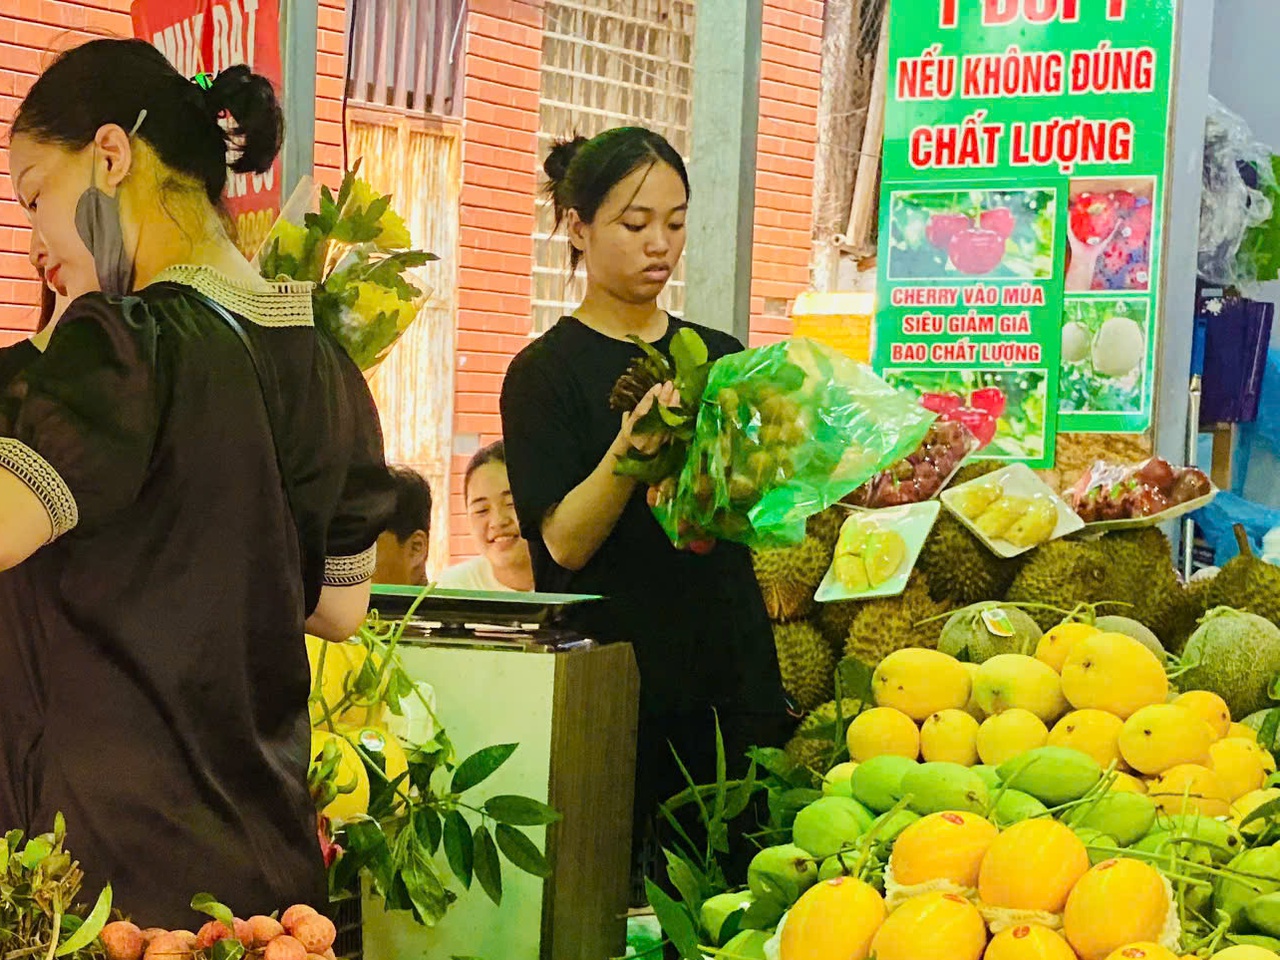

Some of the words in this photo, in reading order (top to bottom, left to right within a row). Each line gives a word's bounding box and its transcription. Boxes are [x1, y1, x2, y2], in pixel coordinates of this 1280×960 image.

[897, 45, 956, 99] NẾU
[962, 47, 1063, 96] KHÔNG
[1070, 42, 1154, 92] ĐÚNG
[911, 111, 1002, 167] CHẤT
[1011, 118, 1132, 172] LƯỢNG
[891, 287, 958, 305] CHERRY
[963, 283, 998, 304] VÀO
[1003, 283, 1044, 304] MÙA
[903, 311, 943, 333] SIÊU
[948, 309, 995, 333] GIẢM
[999, 310, 1030, 333] GIÁ
[891, 344, 927, 361] BAO
[931, 337, 978, 361] CHẤT
[981, 343, 1041, 365] LƯỢNG
